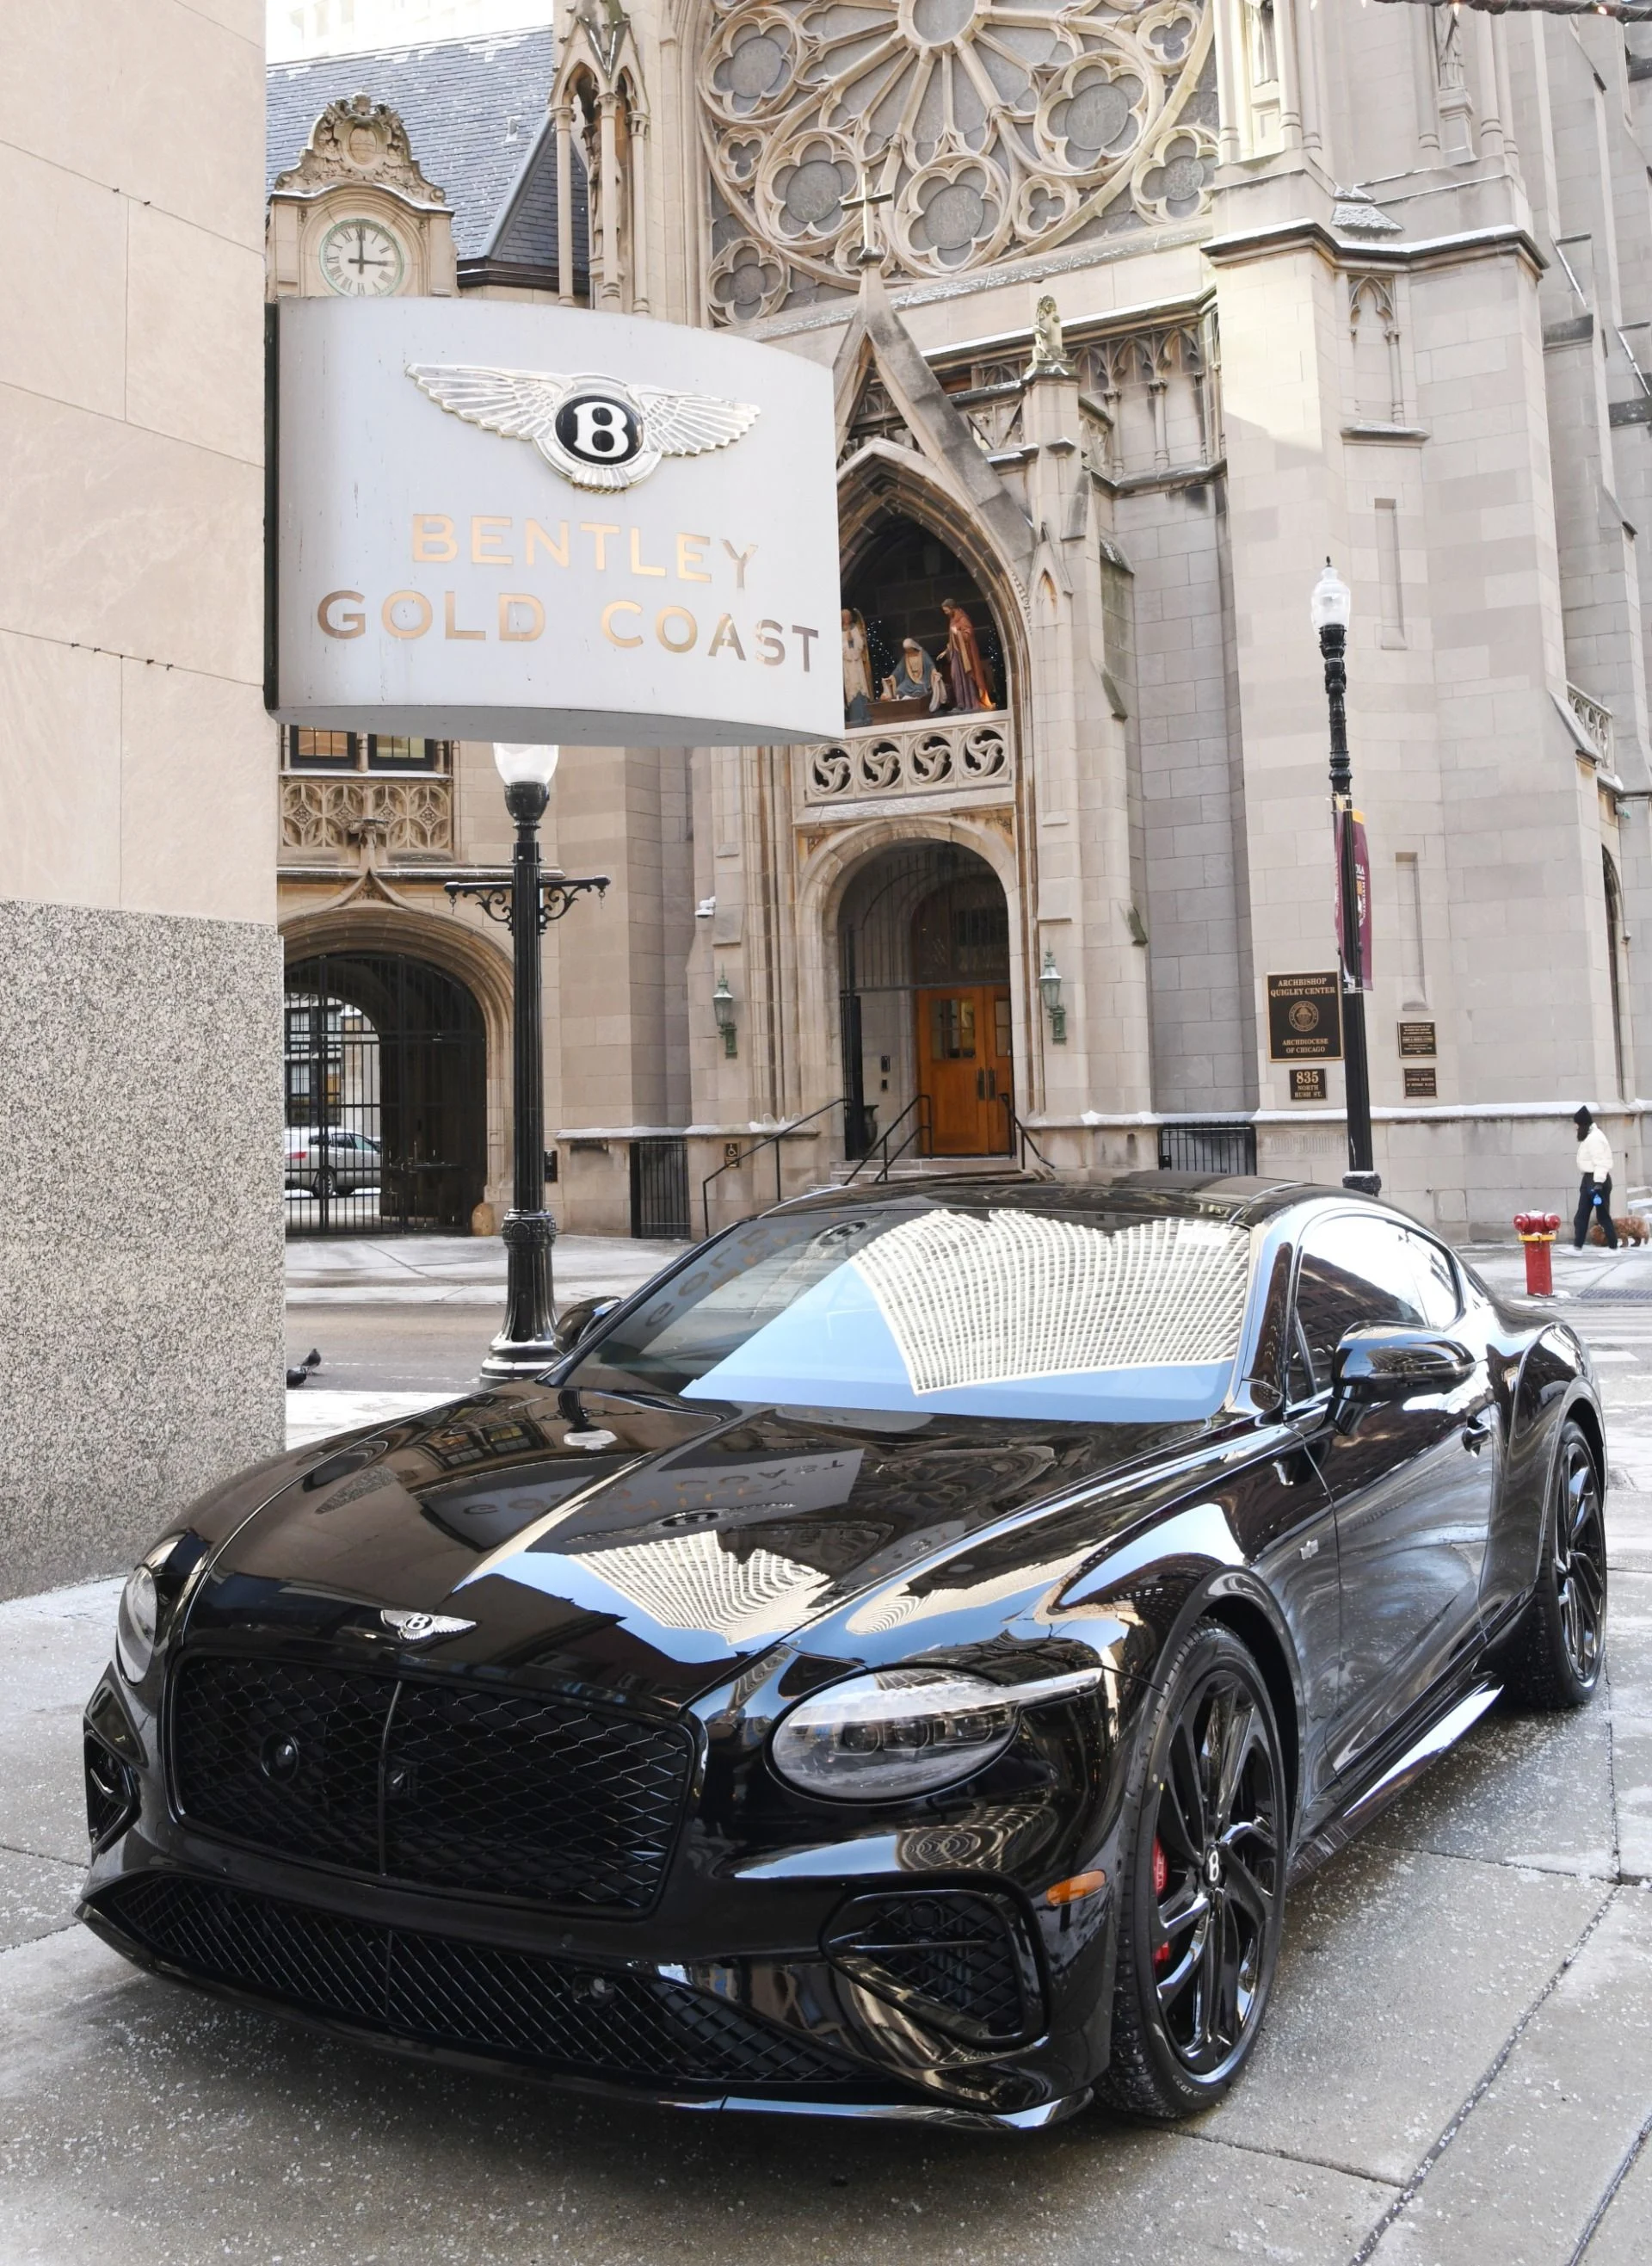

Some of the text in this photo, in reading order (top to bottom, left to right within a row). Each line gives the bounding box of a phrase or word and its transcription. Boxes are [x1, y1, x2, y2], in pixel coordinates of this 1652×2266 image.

[571, 400, 630, 459] B
[412, 513, 758, 589] BENTLEY
[317, 589, 819, 672] GOLD COAST
[1270, 986, 1335, 997] QUIGLEY CENTER
[1278, 977, 1328, 987] ARCHBISHOP
[1296, 1071, 1319, 1084] 835
